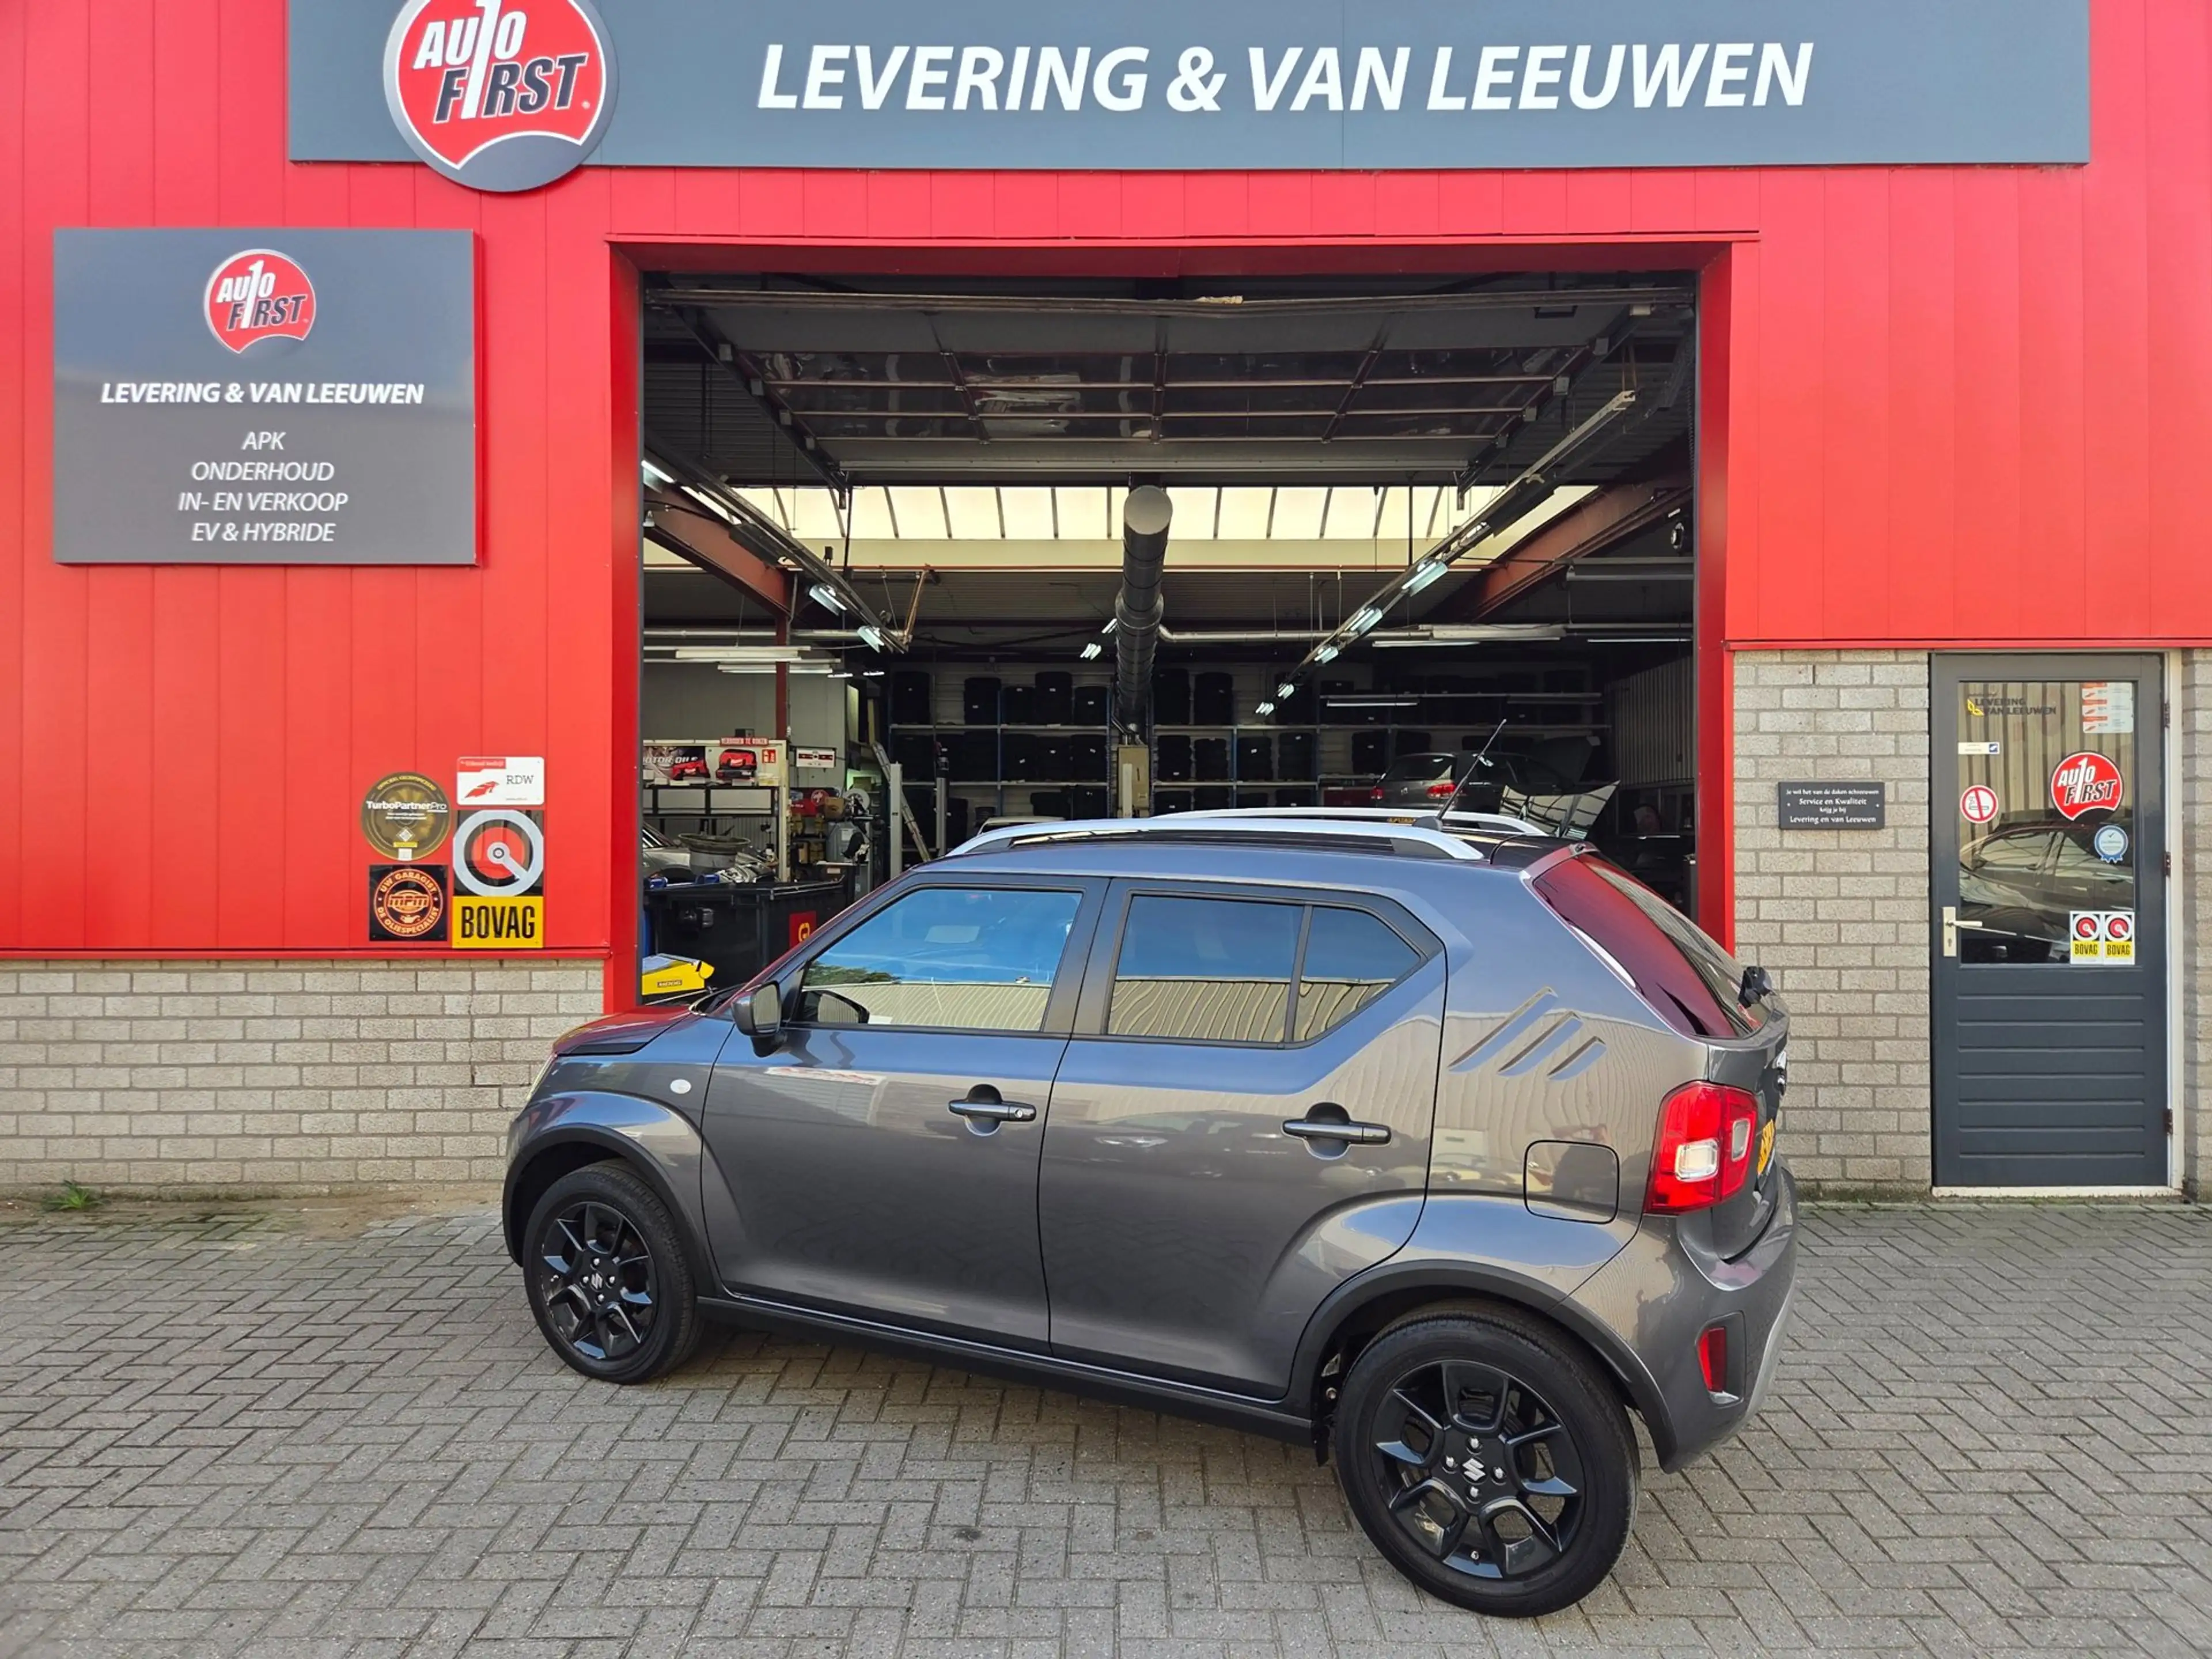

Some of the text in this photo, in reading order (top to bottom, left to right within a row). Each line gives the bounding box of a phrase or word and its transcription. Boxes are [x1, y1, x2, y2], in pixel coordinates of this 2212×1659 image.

[757, 43, 1813, 112] LEVERING & VAN LEEUWEN
[100, 383, 424, 404] LEVERING & VAN LEEUWEN
[241, 431, 286, 451] APK
[191, 462, 335, 482] ONDERHOUD
[177, 493, 349, 512] IN- EN VERKOOP
[192, 522, 336, 542] EV & HYBRIDE
[1975, 698, 2027, 706] LEVERING
[506, 775, 534, 785] RDW
[366, 801, 447, 810] TurboPartnerPro
[1790, 816, 1819, 824] Levering
[380, 872, 438, 892] UW GARAGIST
[384, 907, 440, 934] OLIESPECIALIST
[461, 906, 535, 938] BOVAG
[2075, 943, 2131, 956] BOVAG BOVAG
